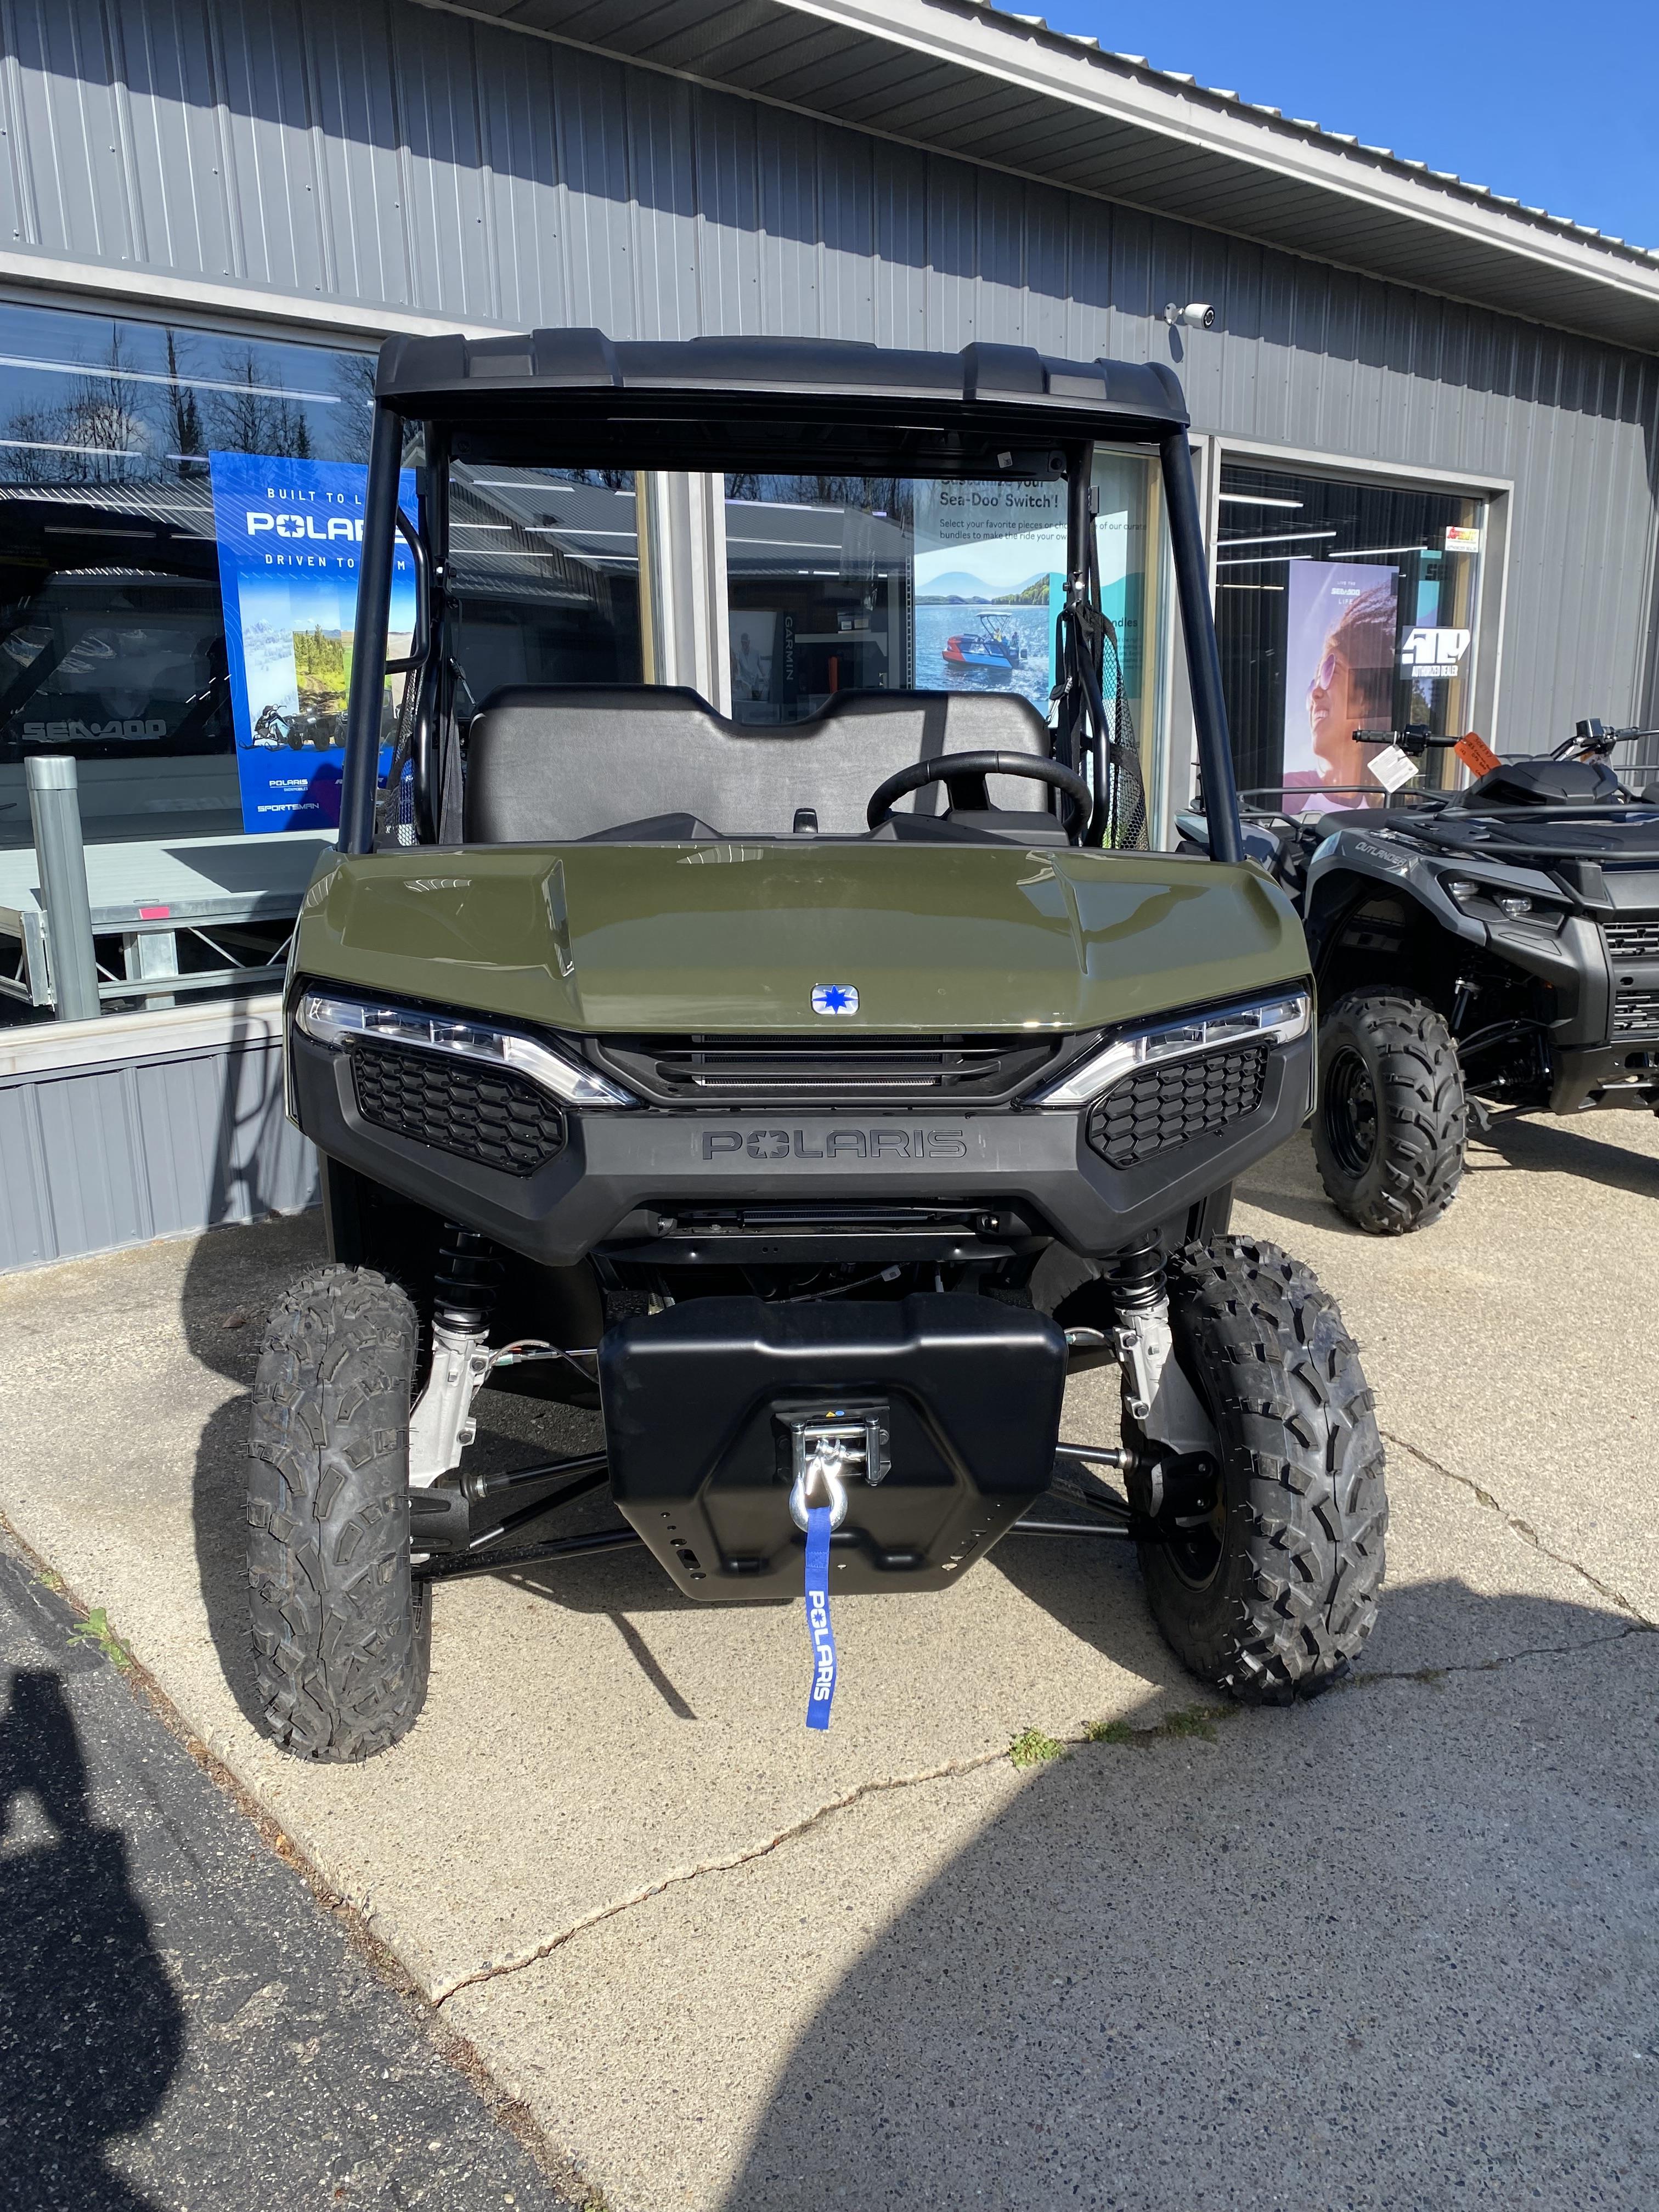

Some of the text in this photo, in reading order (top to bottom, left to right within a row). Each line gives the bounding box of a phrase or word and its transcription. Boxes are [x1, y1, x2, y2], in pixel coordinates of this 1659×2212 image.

[267, 488, 315, 501] BUILT
[326, 493, 345, 504] TO
[246, 512, 409, 544] POLA
[940, 519, 964, 528] Select
[967, 521, 984, 529] your
[986, 520, 1016, 528] favorite
[1018, 521, 1042, 531] pieces
[1099, 521, 1108, 529] of
[940, 531, 970, 539] bundles
[984, 531, 1003, 539] make
[1005, 531, 1018, 539] the
[1020, 532, 1035, 540] ride
[1037, 534, 1054, 543] your
[266, 555, 355, 568] DRIVEN TO
[785, 617, 794, 680] GARMIN
[1441, 665, 1458, 676] DEALER
[257, 803, 319, 812] SPORTSMAN
[1355, 842, 1407, 866] OUTLANDER
[702, 1130, 967, 1160] POLARIS
[809, 1590, 833, 1701] POLARIS
